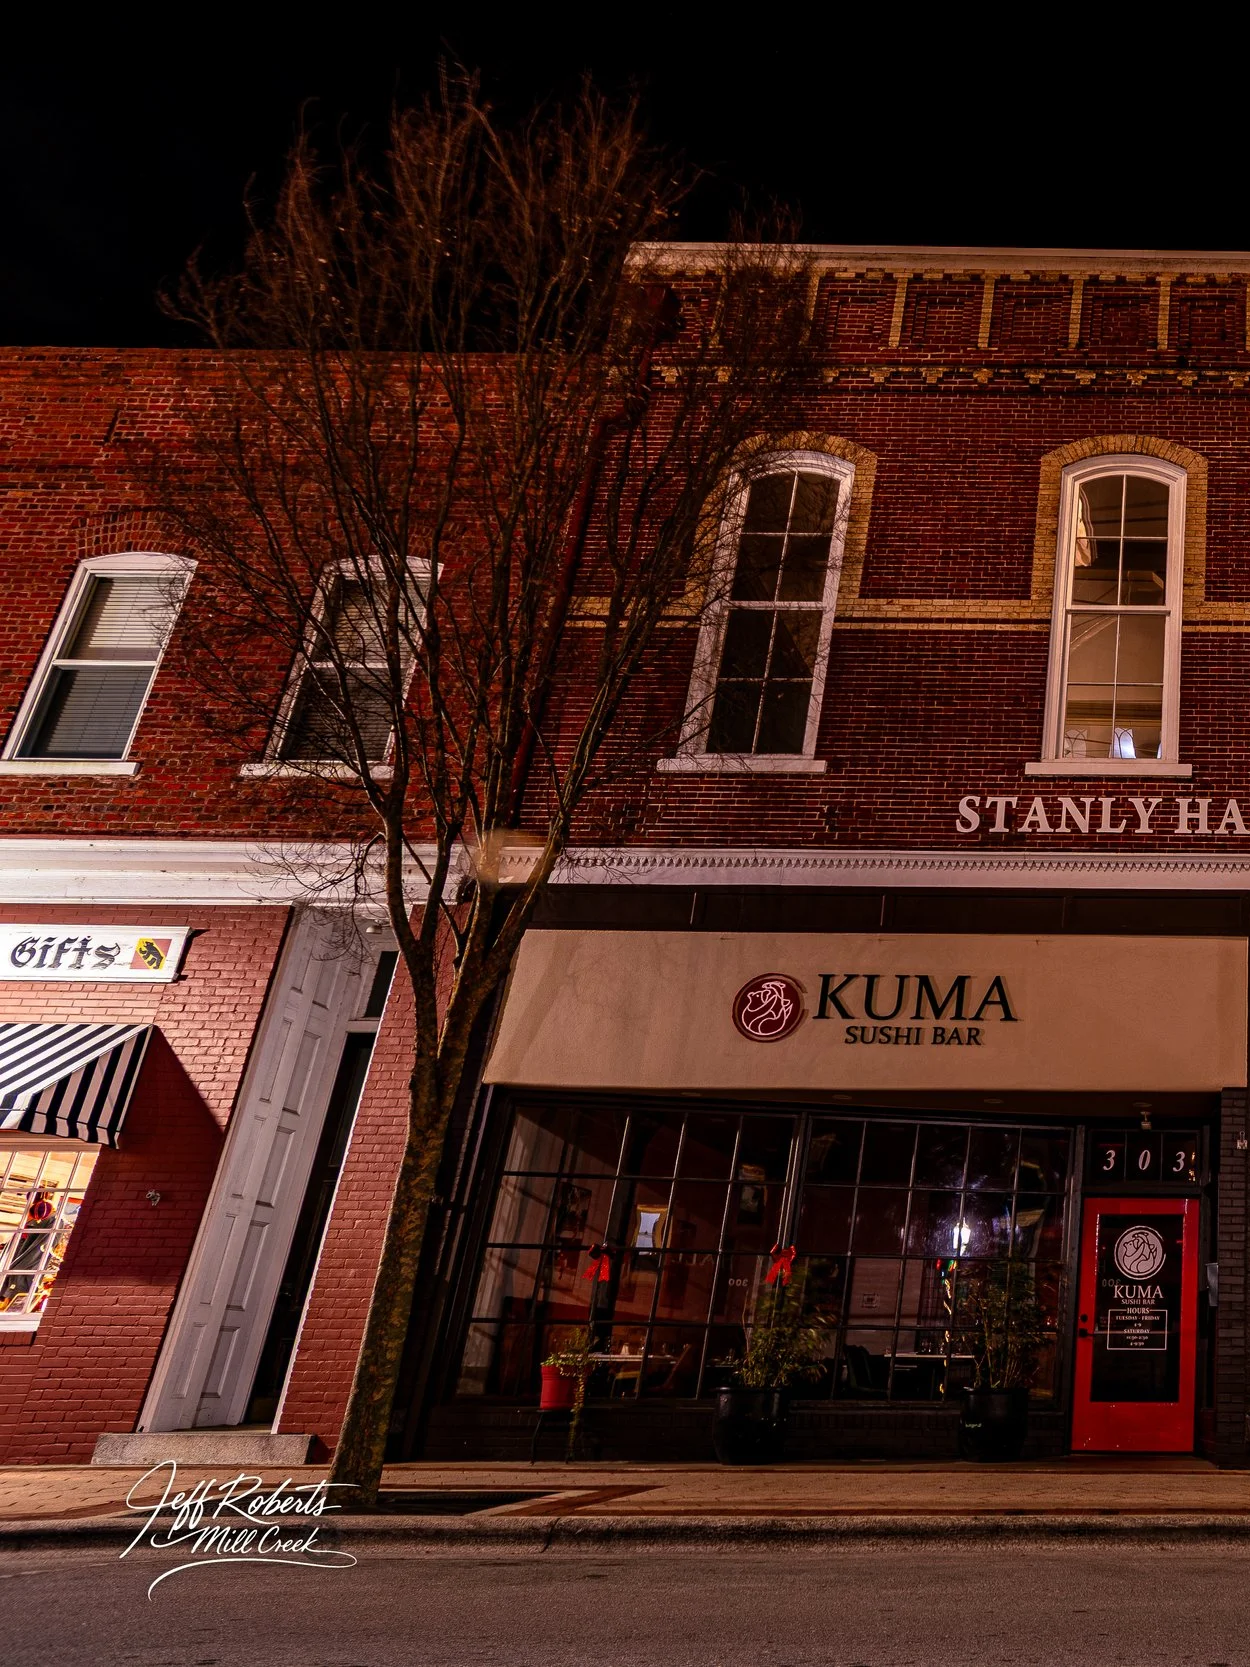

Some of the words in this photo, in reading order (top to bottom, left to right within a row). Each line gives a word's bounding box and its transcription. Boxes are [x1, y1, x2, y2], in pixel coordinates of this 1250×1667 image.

[955, 795, 1163, 833] STANLY
[10, 935, 121, 970] Gifts
[812, 973, 1018, 1021] KUMA
[844, 1025, 921, 1045] SUSHI
[931, 1027, 982, 1046] BAR
[1113, 1285, 1164, 1299] KUMA
[1126, 1307, 1150, 1315] HOURS
